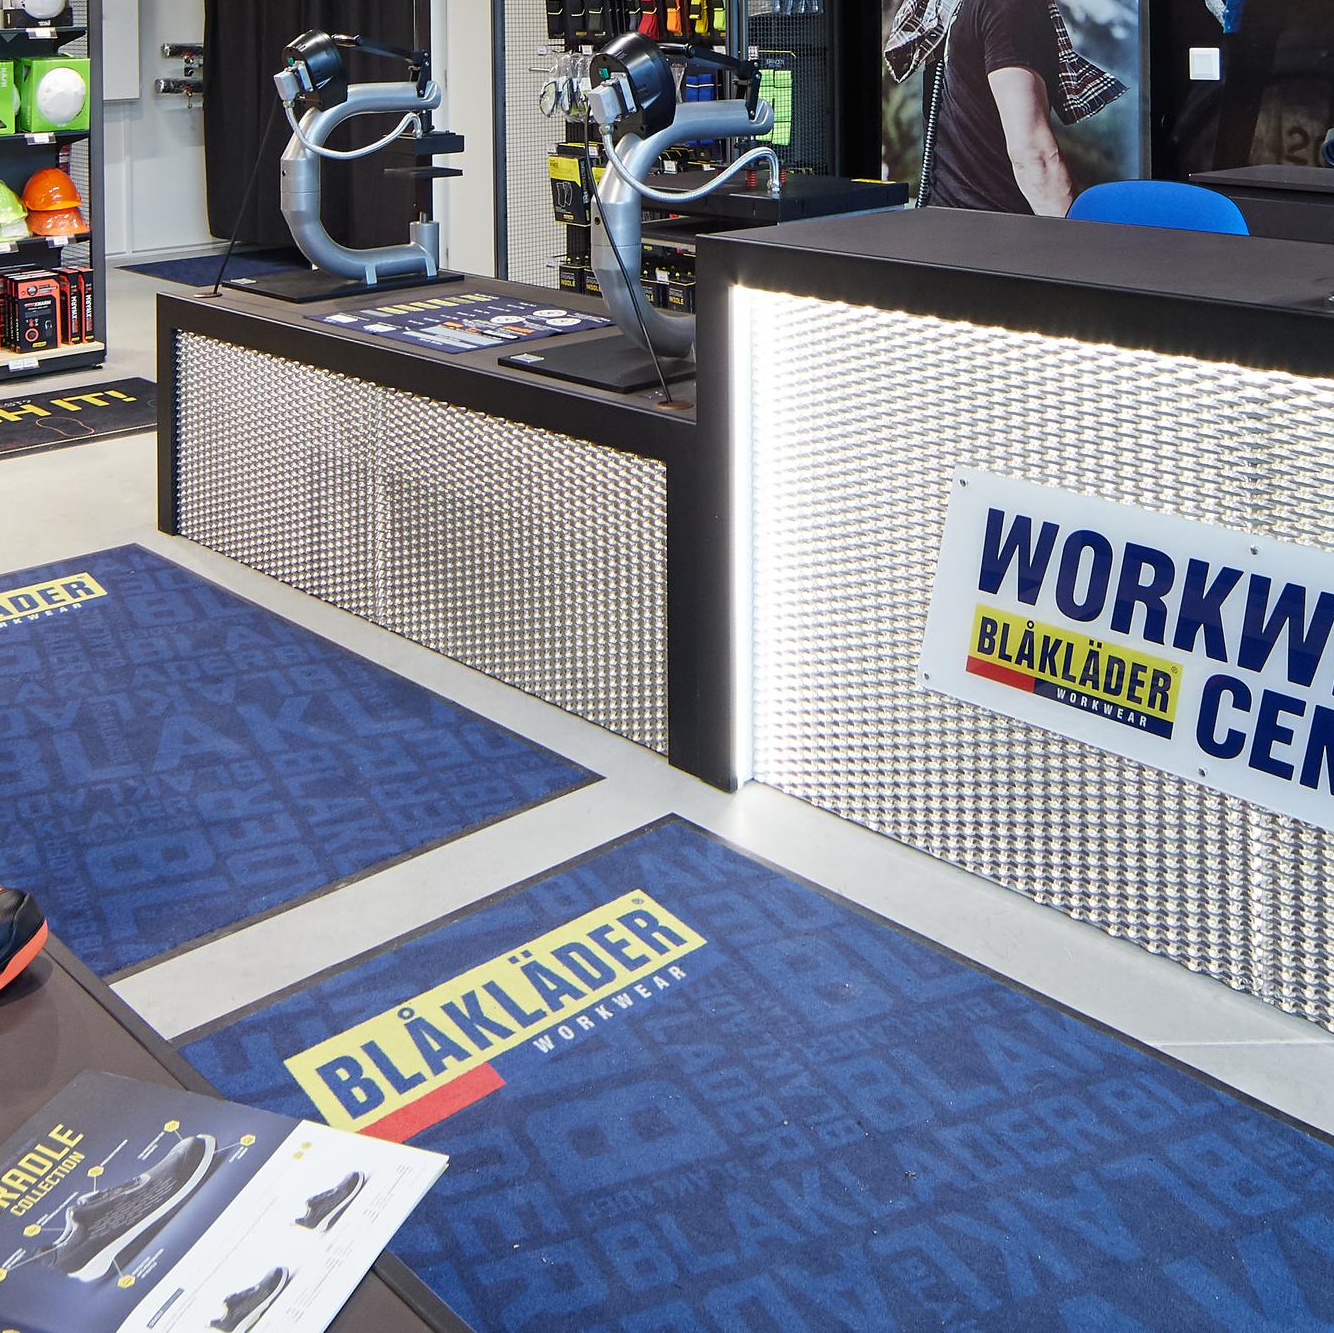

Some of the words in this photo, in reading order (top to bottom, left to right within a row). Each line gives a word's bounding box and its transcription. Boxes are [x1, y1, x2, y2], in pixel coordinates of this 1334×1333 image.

[977, 618, 1174, 713] BLÅKLÄDER
[1056, 687, 1149, 729] WORKWEAR
[315, 908, 688, 1121] BLÅKLÄDER
[531, 963, 687, 1054] WORKWEAR
[9, 1151, 85, 1217] COLLECTION
